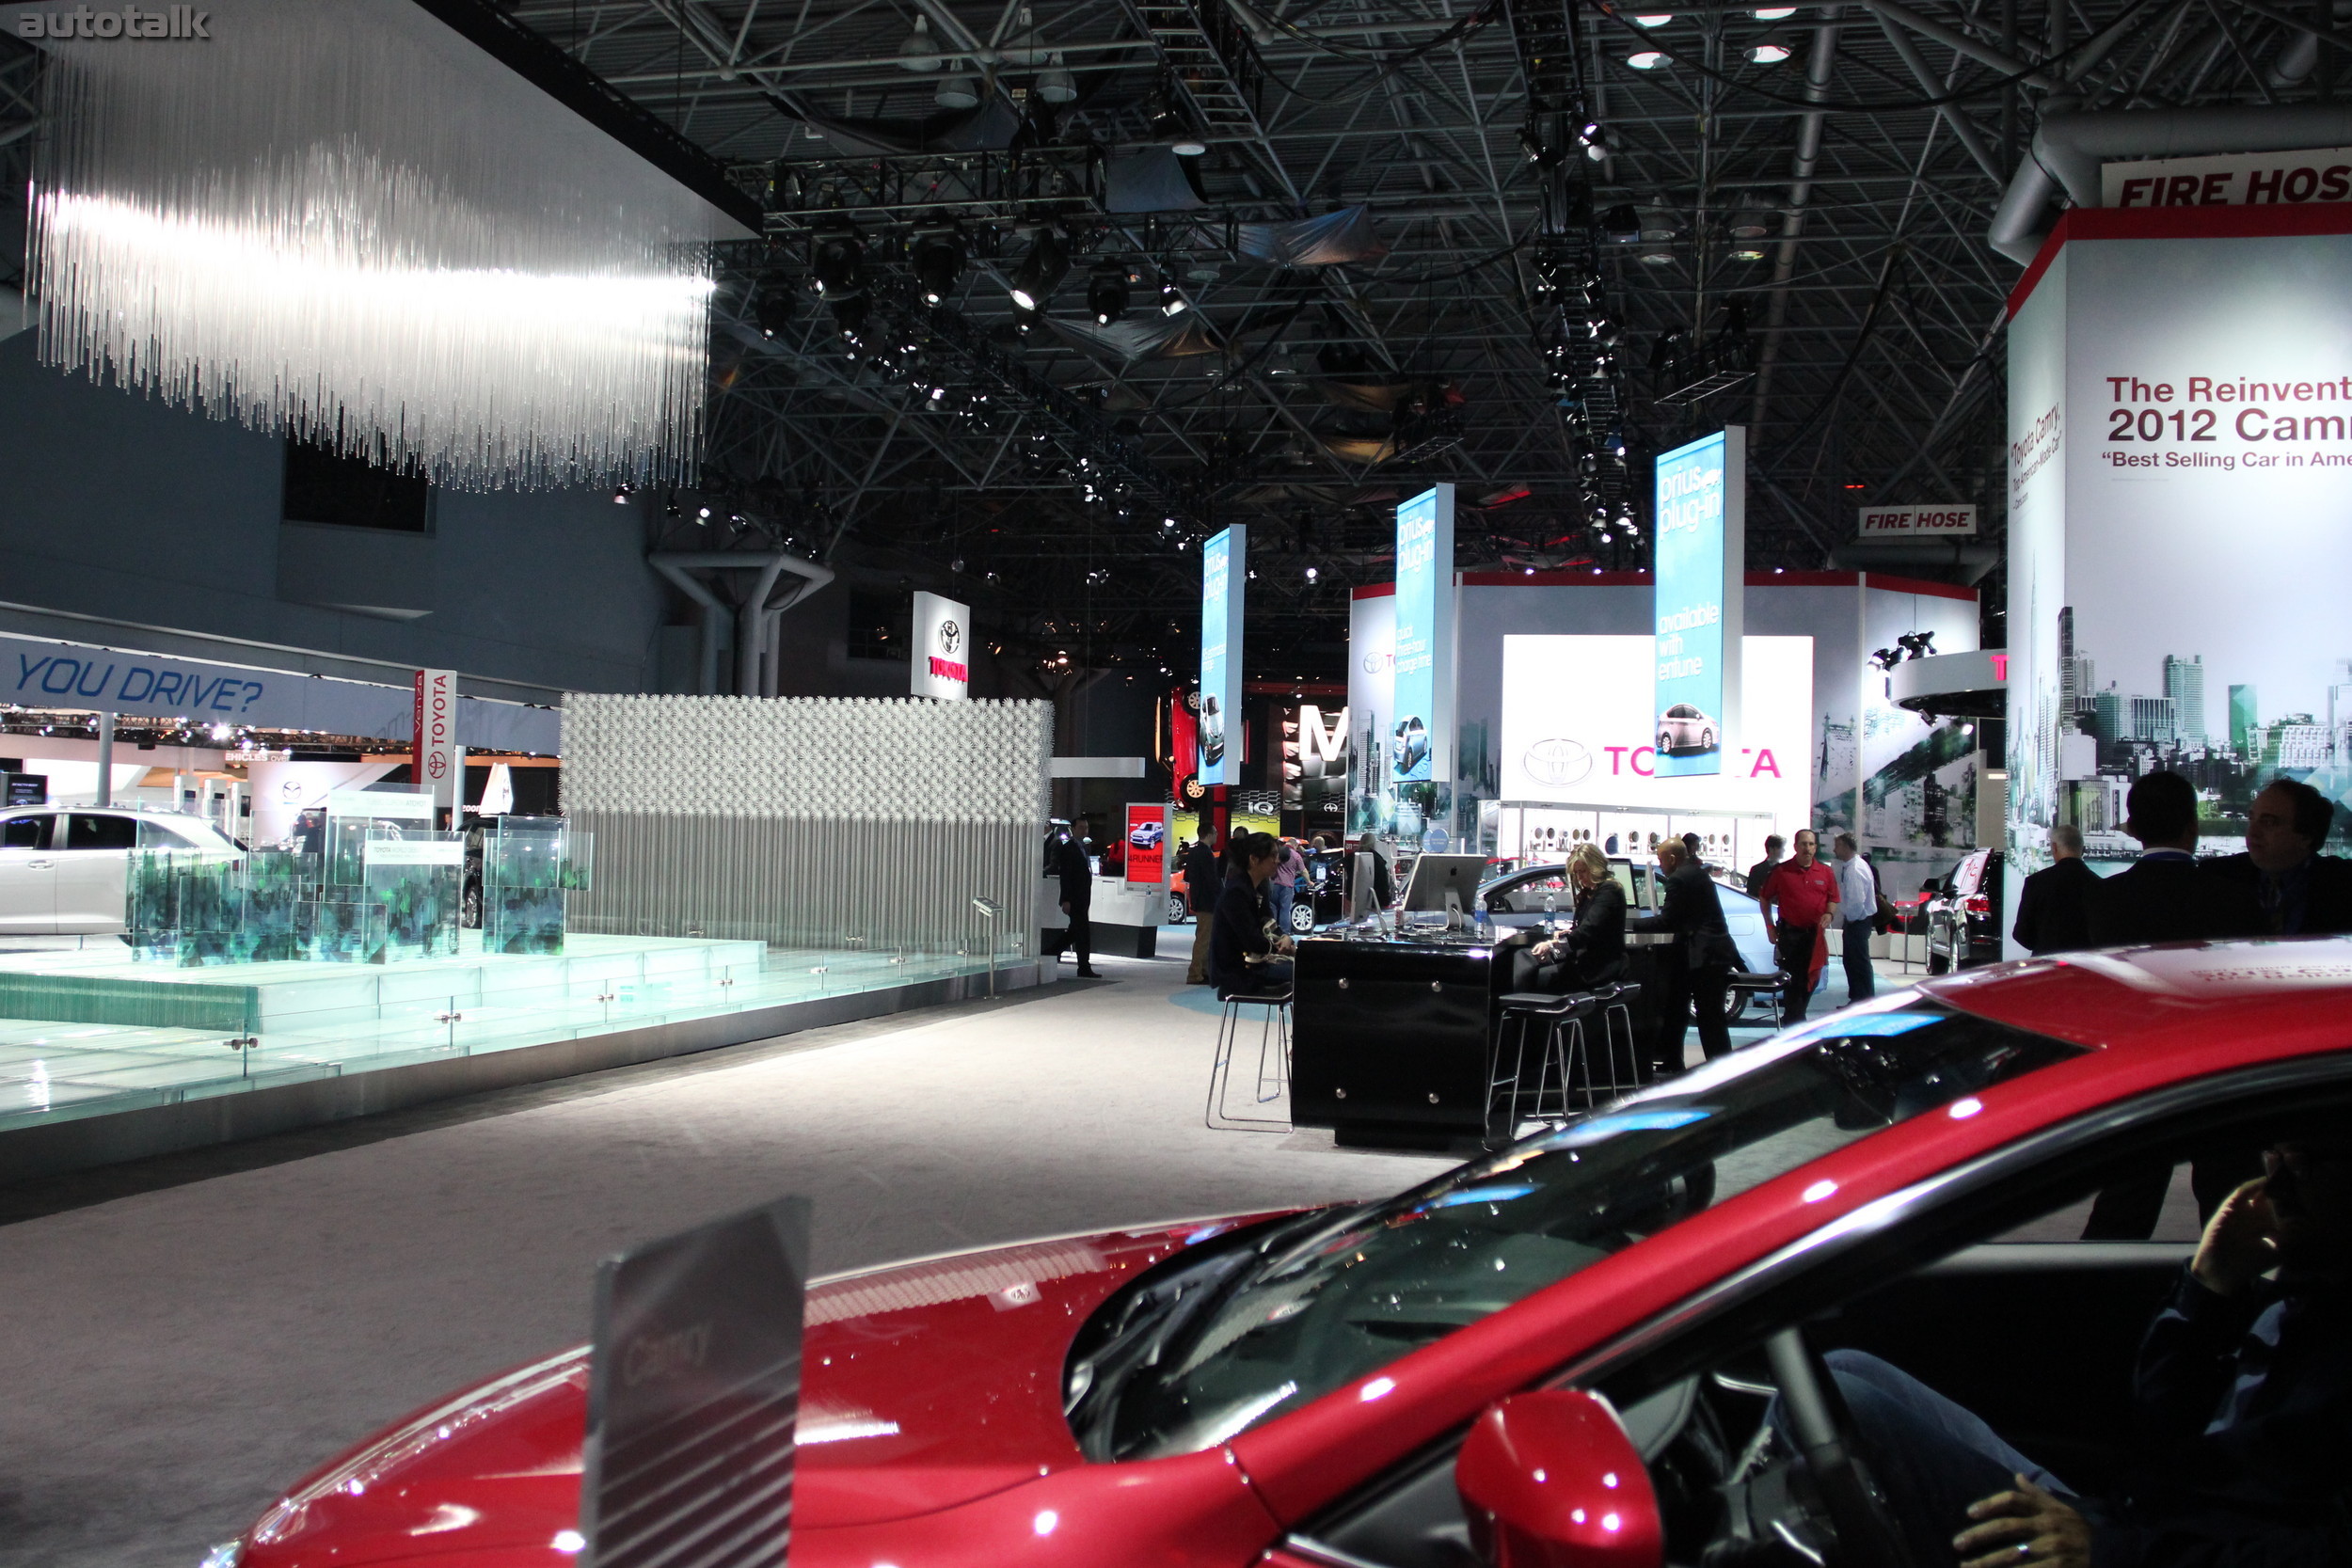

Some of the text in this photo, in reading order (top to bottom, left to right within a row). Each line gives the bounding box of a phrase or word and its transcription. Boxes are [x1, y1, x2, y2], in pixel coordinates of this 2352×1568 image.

[2120, 165, 2352, 207] FIRE HOS
[2106, 376, 2352, 403] The Reinvent
[2108, 407, 2352, 441] 2012 Cam
[2102, 451, 2160, 468] “Best
[2165, 451, 2235, 471] Selling
[2242, 451, 2280, 468] Car
[2286, 451, 2304, 467] in
[1661, 466, 1702, 508] prius
[1660, 487, 1721, 540] plug-in
[1866, 512, 1970, 530] FIRE HOSE
[1398, 515, 1423, 548] prius
[1397, 538, 1434, 577] plug-in
[1659, 602, 1720, 635] available
[1659, 633, 1684, 657] with
[17, 654, 263, 712] YOU DRIVE?
[929, 657, 968, 683] TOYOTA
[1659, 656, 1703, 680] entune
[432, 674, 447, 747] TOYOTA
[1604, 746, 1782, 778] TOA
[1128, 854, 1163, 863] 4RUNNE
